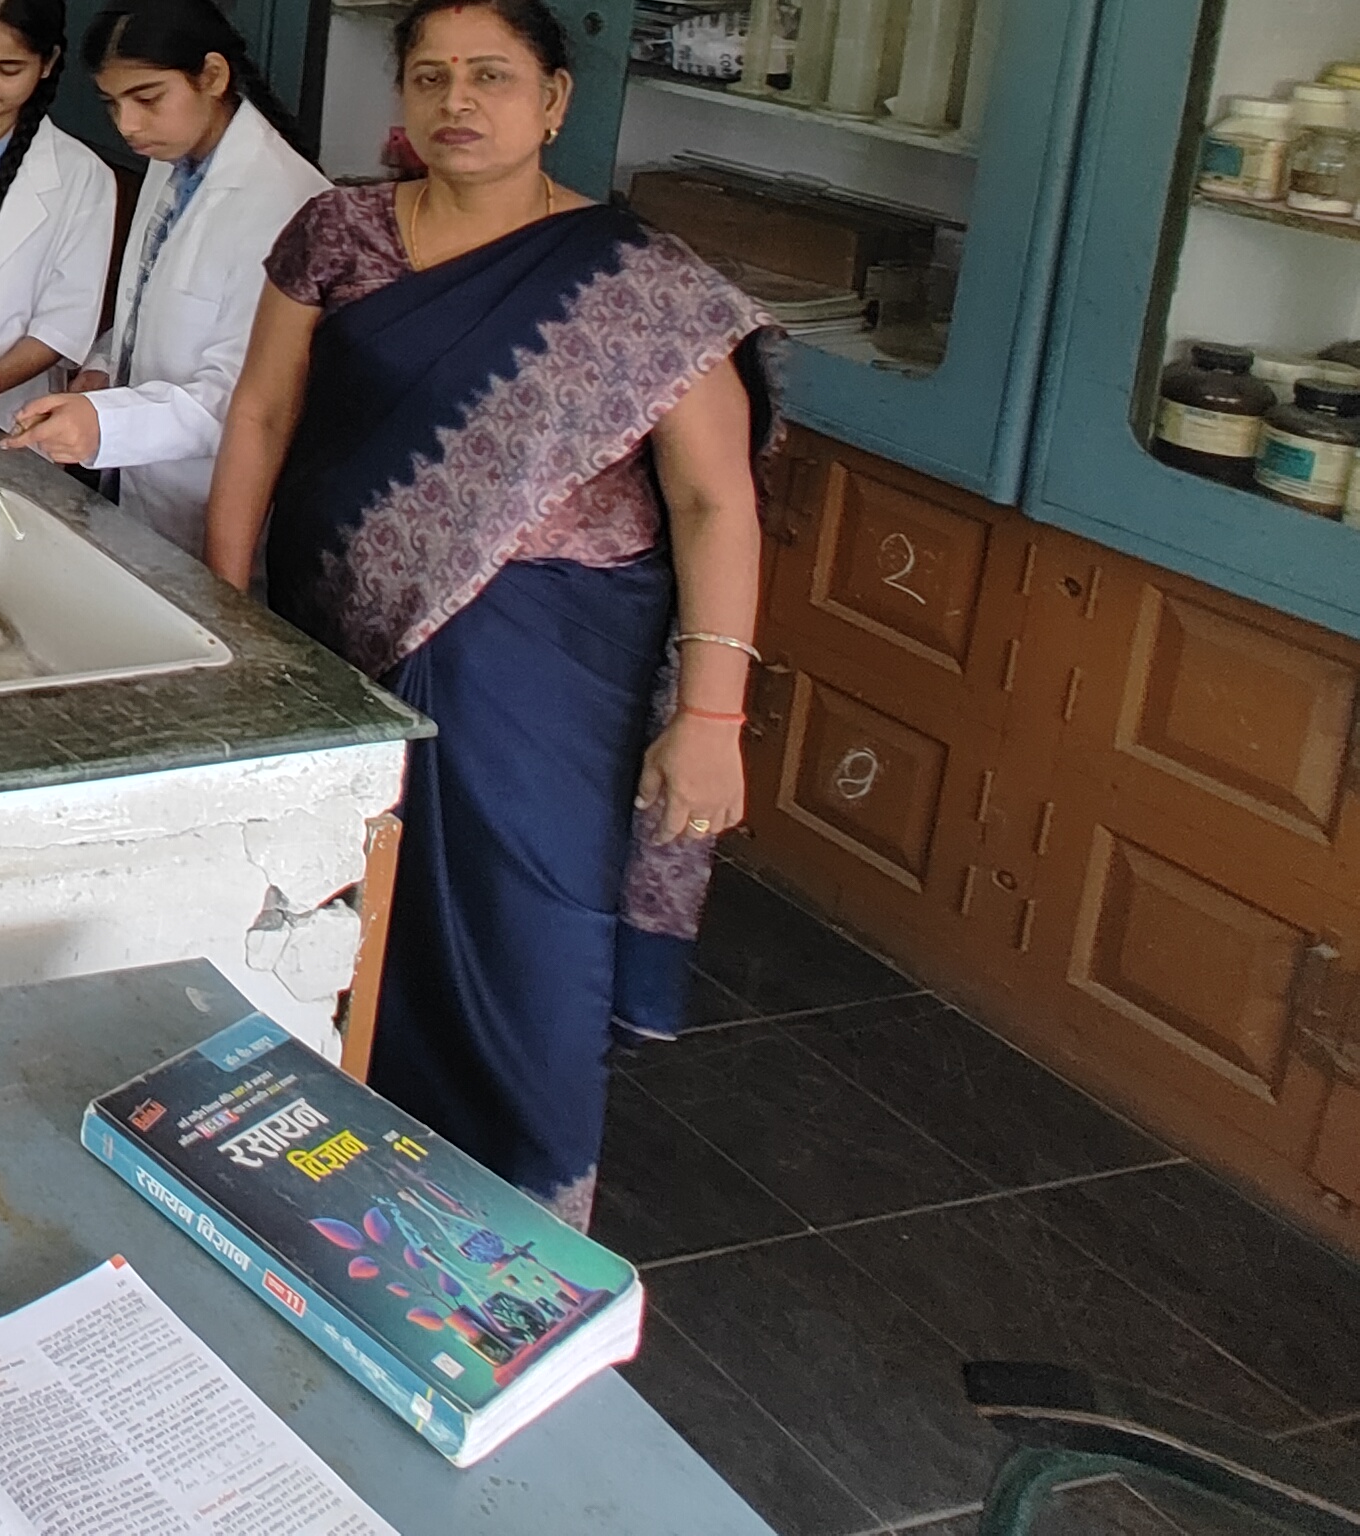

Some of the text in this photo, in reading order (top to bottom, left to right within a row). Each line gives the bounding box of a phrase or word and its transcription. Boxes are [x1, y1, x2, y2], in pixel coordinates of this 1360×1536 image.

[879, 531, 926, 605] 2
[196, 1106, 239, 1139] NCERT
[218, 1097, 330, 1168] रसायन
[393, 1135, 429, 1162] 11
[285, 1129, 370, 1182] विज्ञान
[135, 1165, 252, 1272] रसायन विज्ञान
[282, 1288, 302, 1311] 11
